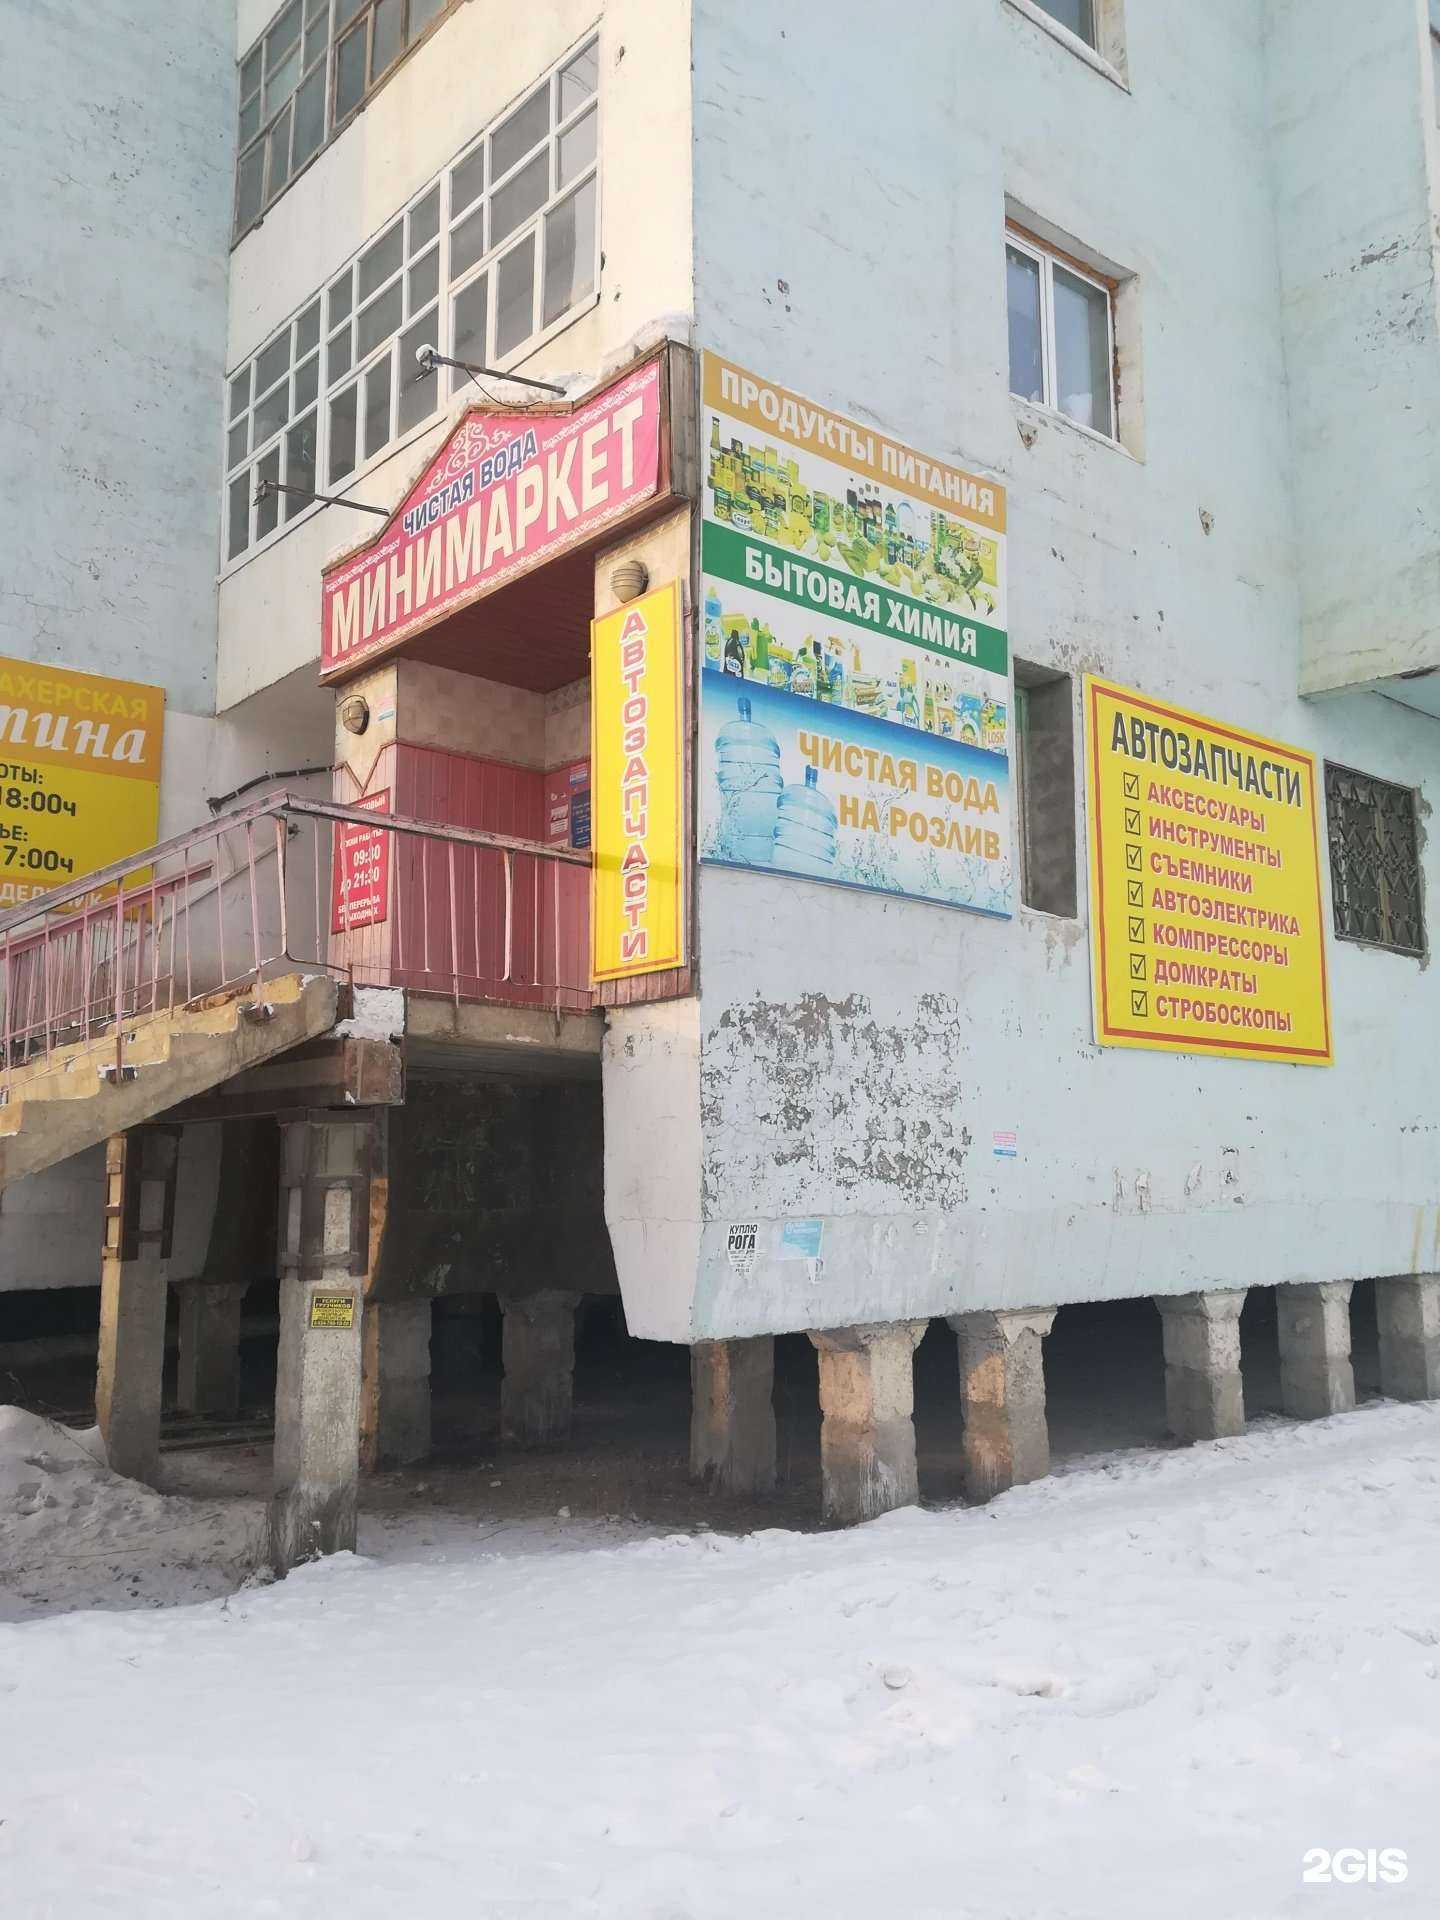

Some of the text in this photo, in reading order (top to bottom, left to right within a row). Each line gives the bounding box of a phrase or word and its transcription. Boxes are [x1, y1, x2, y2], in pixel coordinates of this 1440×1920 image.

[721, 367, 995, 517] ПРОДУКТЫ ПИТАНИЯ
[403, 428, 538, 537] ЧИСТАЯ ВОДА
[331, 395, 645, 658] МИНИМАРКЕТ
[745, 546, 977, 658] БЫТОВАЯ ХИМИЯ
[621, 609, 648, 962] АВТОЗАПЧАСТИ
[799, 731, 1000, 814] ЧИСТАЯ ВОДА
[1111, 711, 1303, 808] АВТОЗАПЧАСТИ
[839, 794, 1000, 861] НА РОЗЛИВ
[1147, 781, 1265, 833] АКСЕССУАРЫ
[1149, 815, 1281, 869] ИНСТРУМЕНТЫ
[1150, 851, 1253, 894] СЪЕМНИКИ
[1151, 887, 1301, 937] АВТОЭЛЕКТРИКА
[1153, 922, 1289, 967] КОМПРЕССОРЫ
[1154, 958, 1258, 995] ДОМКРАТЫ
[1155, 994, 1293, 1033] СТРОБОСКОПЫ
[727, 1234, 756, 1251] РОГА
[729, 1224, 758, 1235] КУПЛЮ
